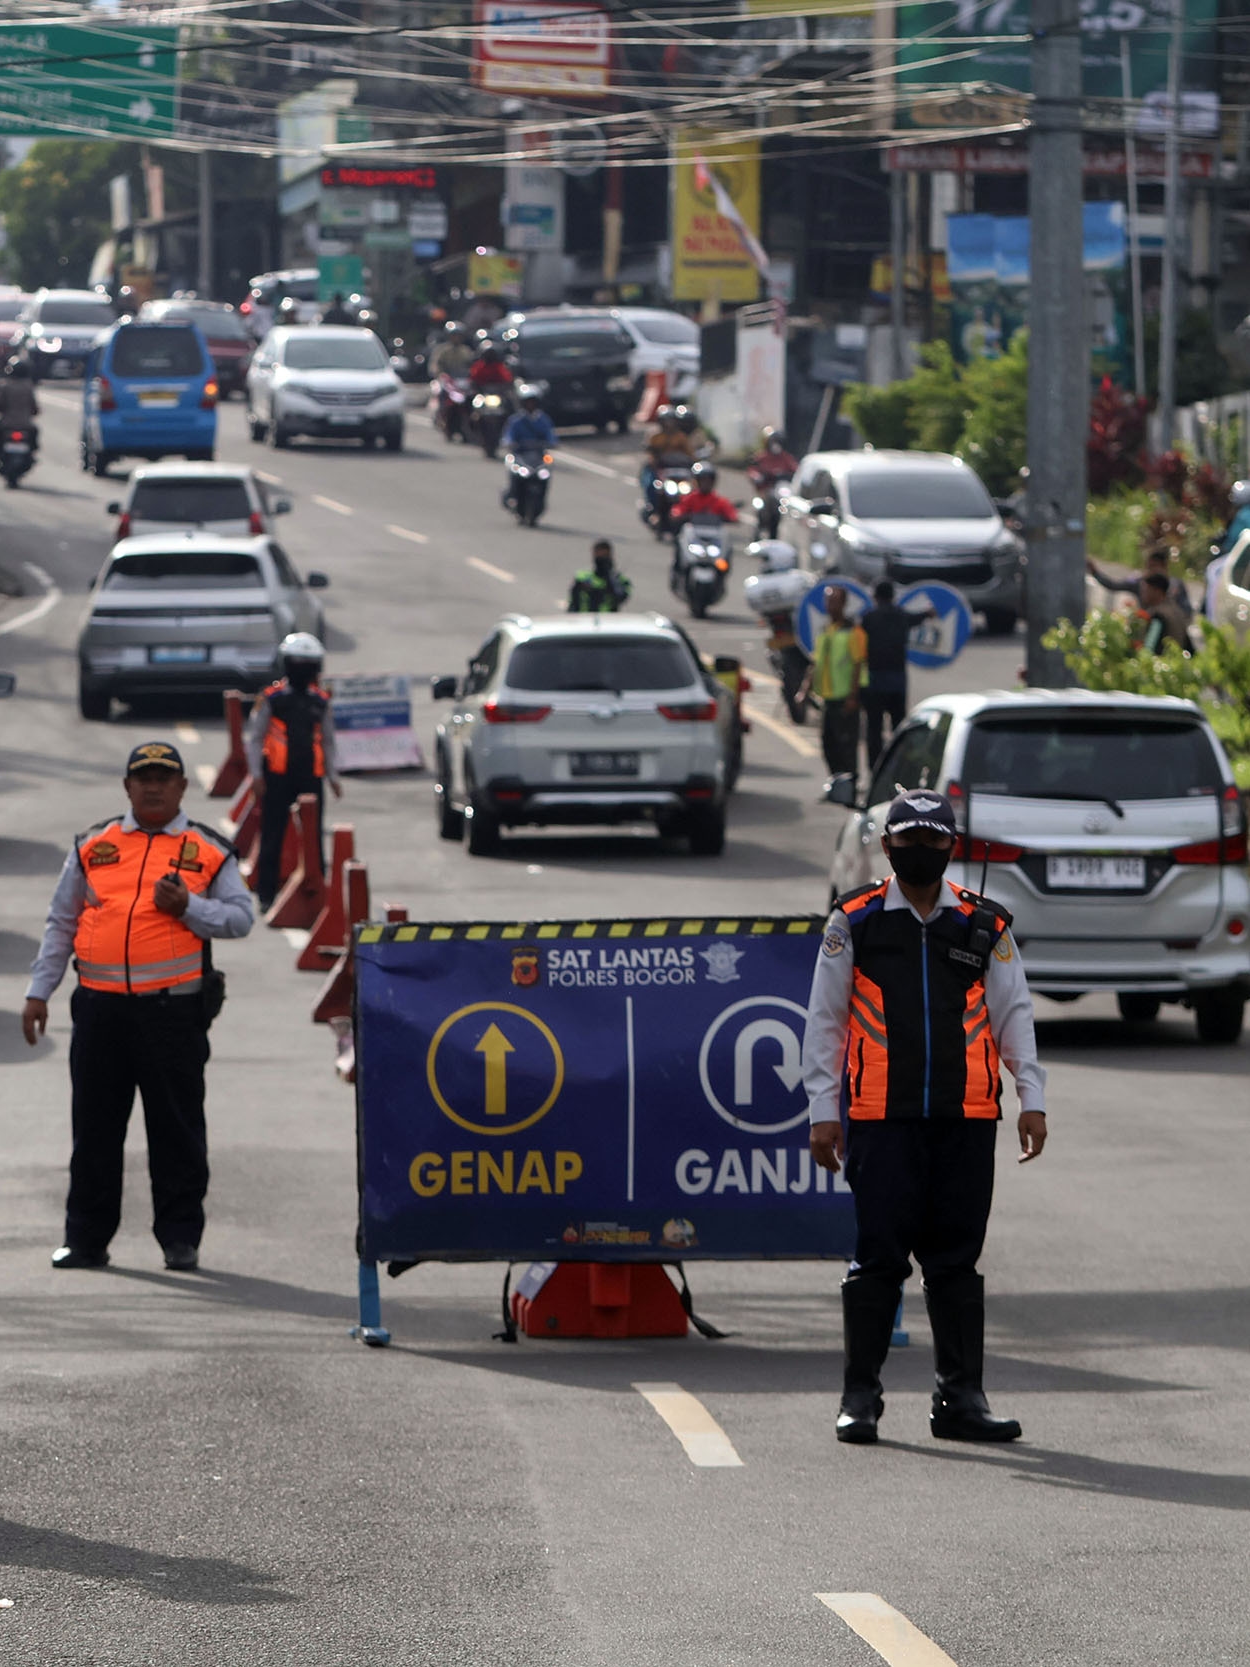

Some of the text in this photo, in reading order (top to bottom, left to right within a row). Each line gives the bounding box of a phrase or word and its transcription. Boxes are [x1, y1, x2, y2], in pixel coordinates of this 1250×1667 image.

[547, 946, 695, 969] SAT LANTAS
[548, 968, 696, 987] POLRES BOGOR
[408, 1150, 584, 1198] GENAP
